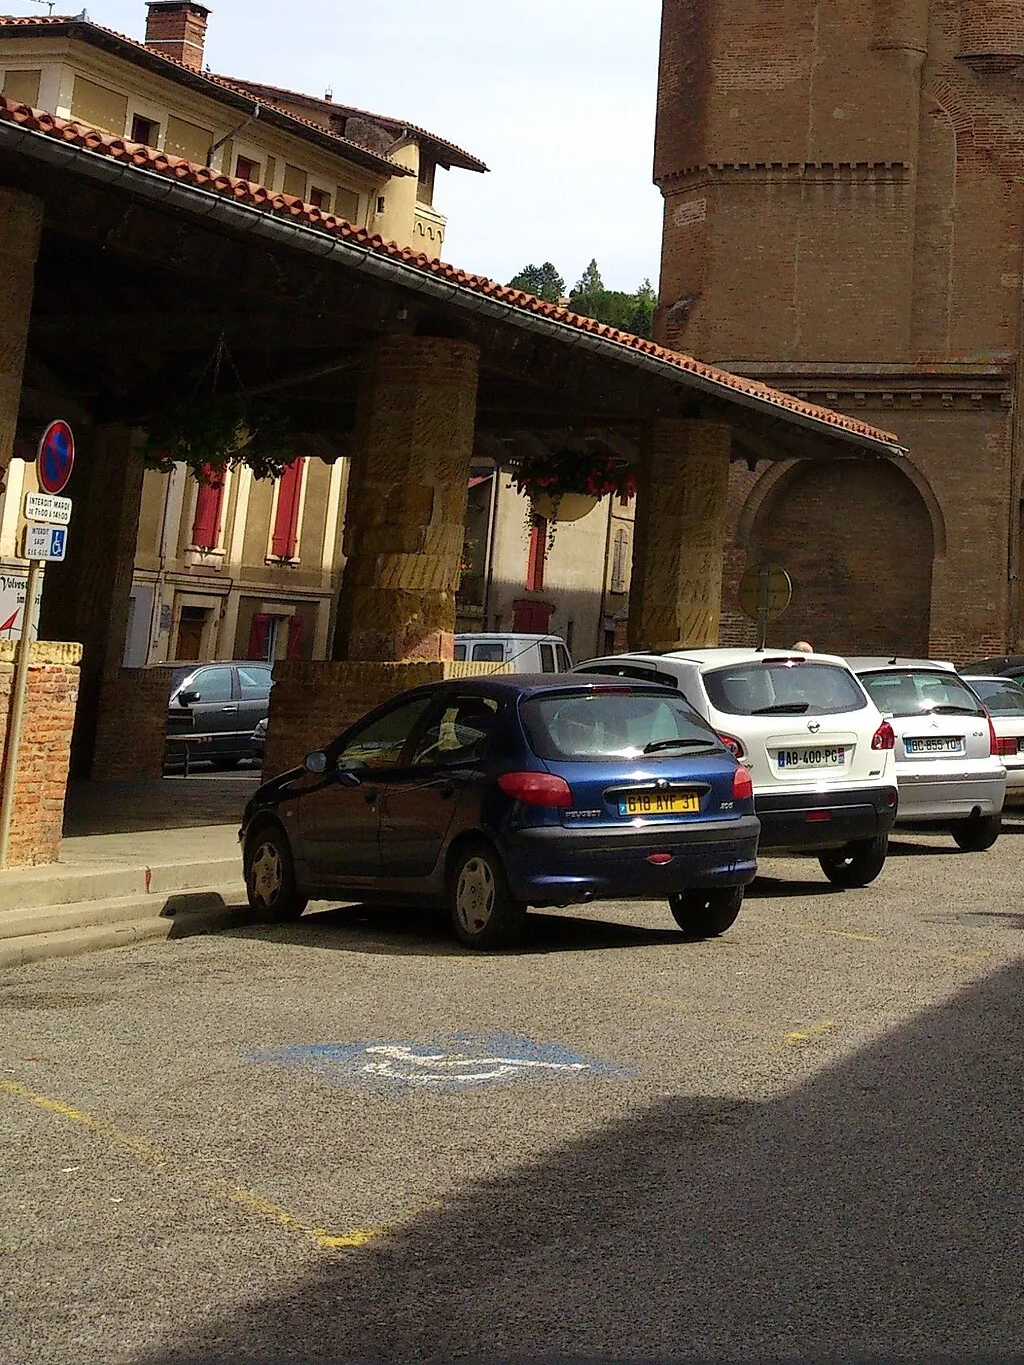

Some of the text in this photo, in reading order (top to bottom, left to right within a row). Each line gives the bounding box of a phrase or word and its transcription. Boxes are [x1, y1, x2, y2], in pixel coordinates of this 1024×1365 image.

[29, 496, 70, 511] INTERDIT MARDI
[32, 527, 49, 535] INTERDIT
[627, 794, 696, 812] 618 AYF 31
